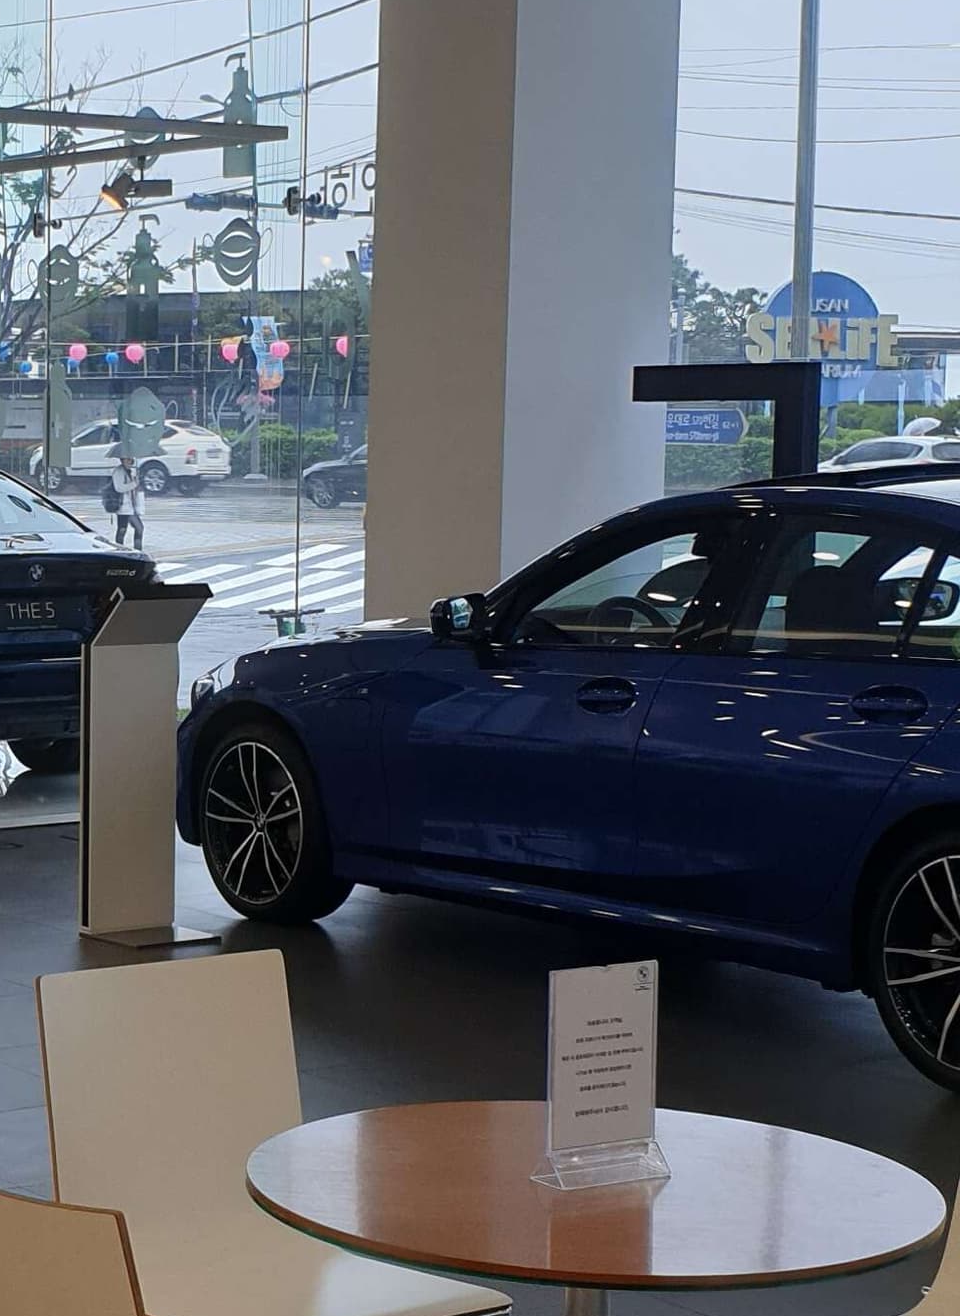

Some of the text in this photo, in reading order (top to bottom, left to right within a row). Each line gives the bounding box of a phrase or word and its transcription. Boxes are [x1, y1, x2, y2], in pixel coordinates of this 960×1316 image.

[821, 363, 861, 378] ARIUM
[6, 601, 56, 619] THE 5
